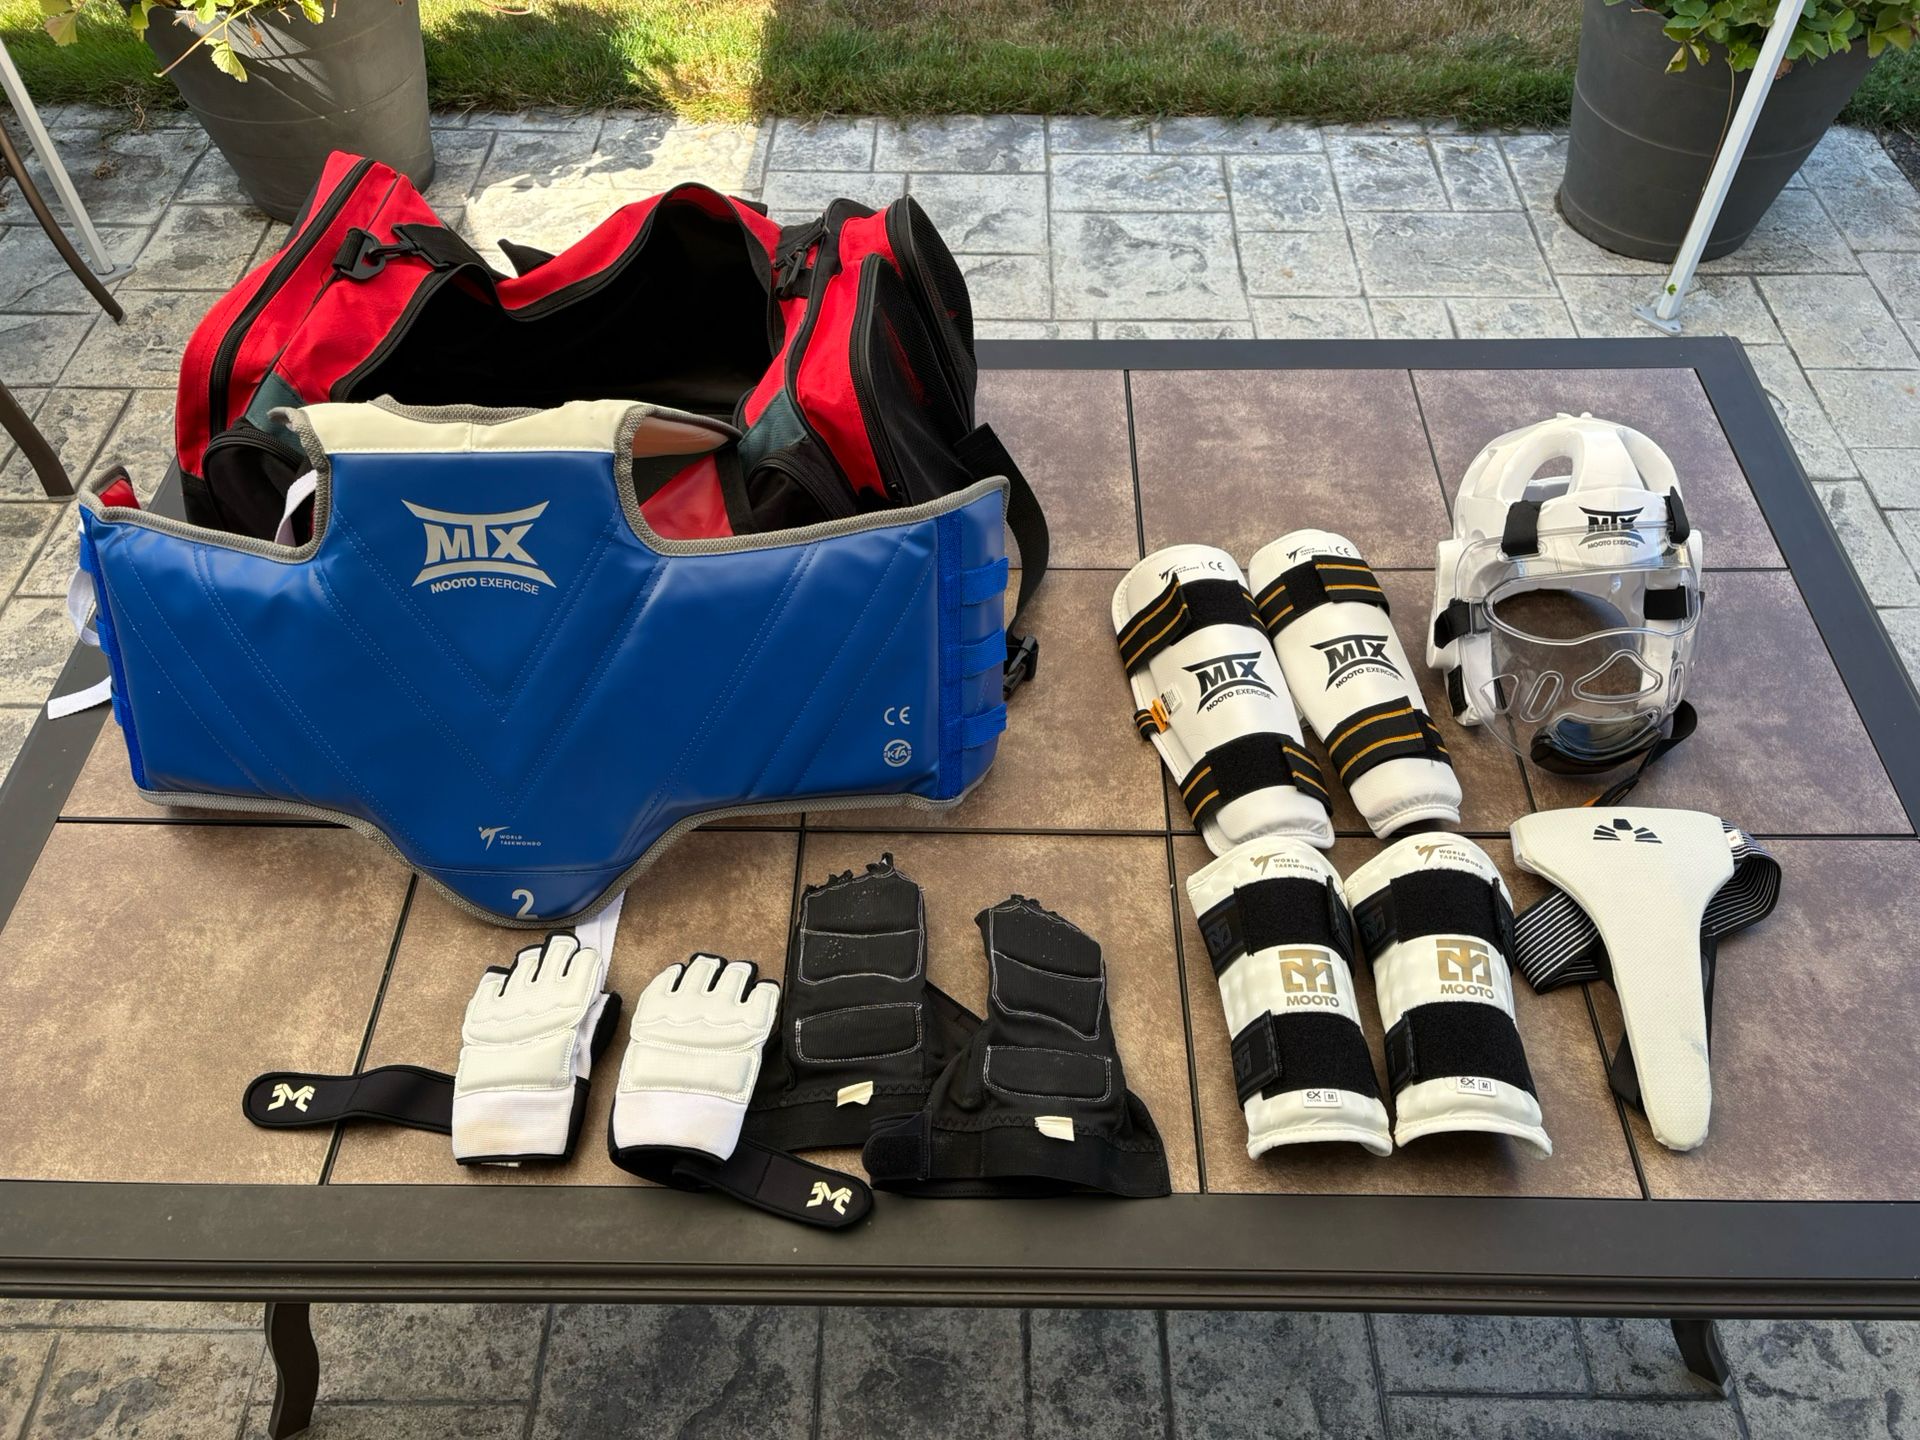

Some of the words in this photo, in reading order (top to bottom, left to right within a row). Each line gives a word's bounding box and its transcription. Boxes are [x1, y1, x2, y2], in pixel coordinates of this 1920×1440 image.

[1578, 506, 1644, 535] MTX
[401, 499, 550, 567] MTX
[430, 577, 477, 594] MOOTO
[480, 577, 540, 596] EXERCISE
[1309, 634, 1394, 675] MTX
[1181, 651, 1267, 698] MTX
[1335, 668, 1365, 689] MOOTO
[1206, 691, 1235, 712] MOOTO
[884, 706, 910, 725] CE
[511, 888, 539, 920] 2
[1286, 994, 1340, 1007] MOOTO
[1440, 983, 1495, 999] MOOTO
